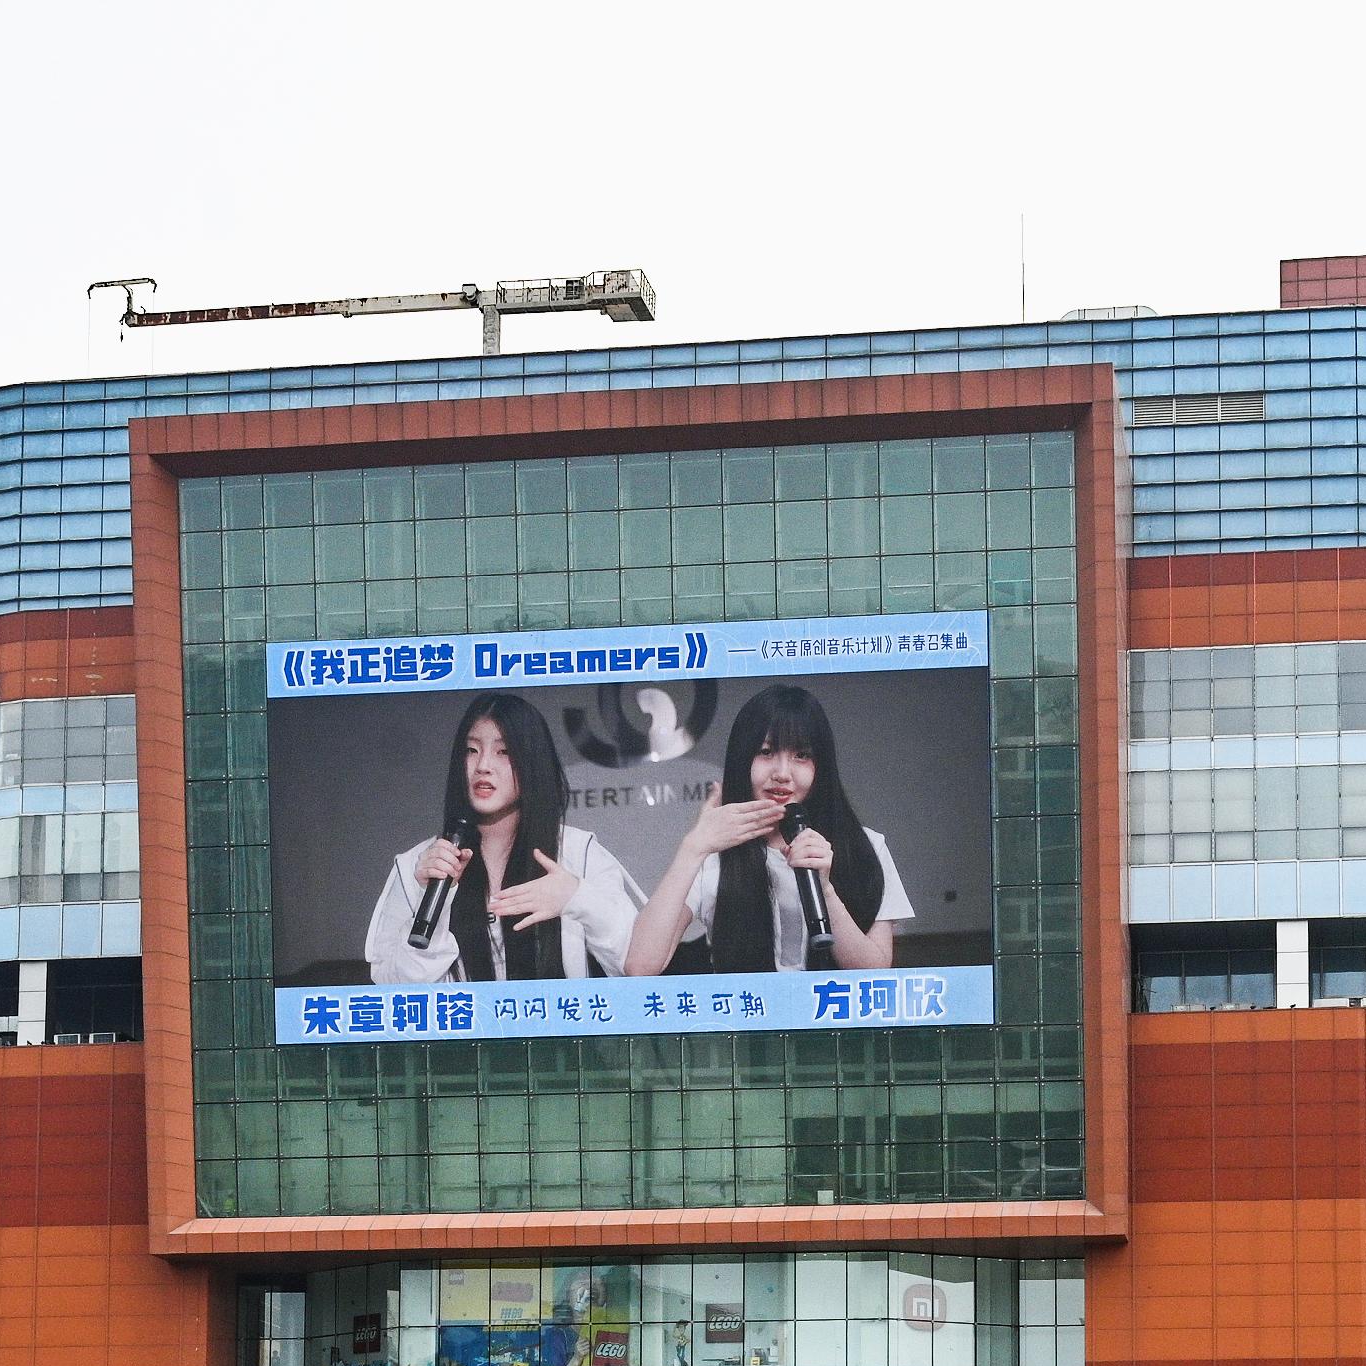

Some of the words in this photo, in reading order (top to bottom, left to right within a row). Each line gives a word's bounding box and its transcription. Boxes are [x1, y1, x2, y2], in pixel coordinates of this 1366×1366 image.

[494, 996, 614, 1023] 闪闪发光
[643, 991, 767, 1019] 未来可期
[813, 978, 943, 1020] 方珂欣
[708, 1315, 742, 1331] LEGO
[355, 1327, 377, 1341] LEGO
[595, 1343, 626, 1358] LEGO
